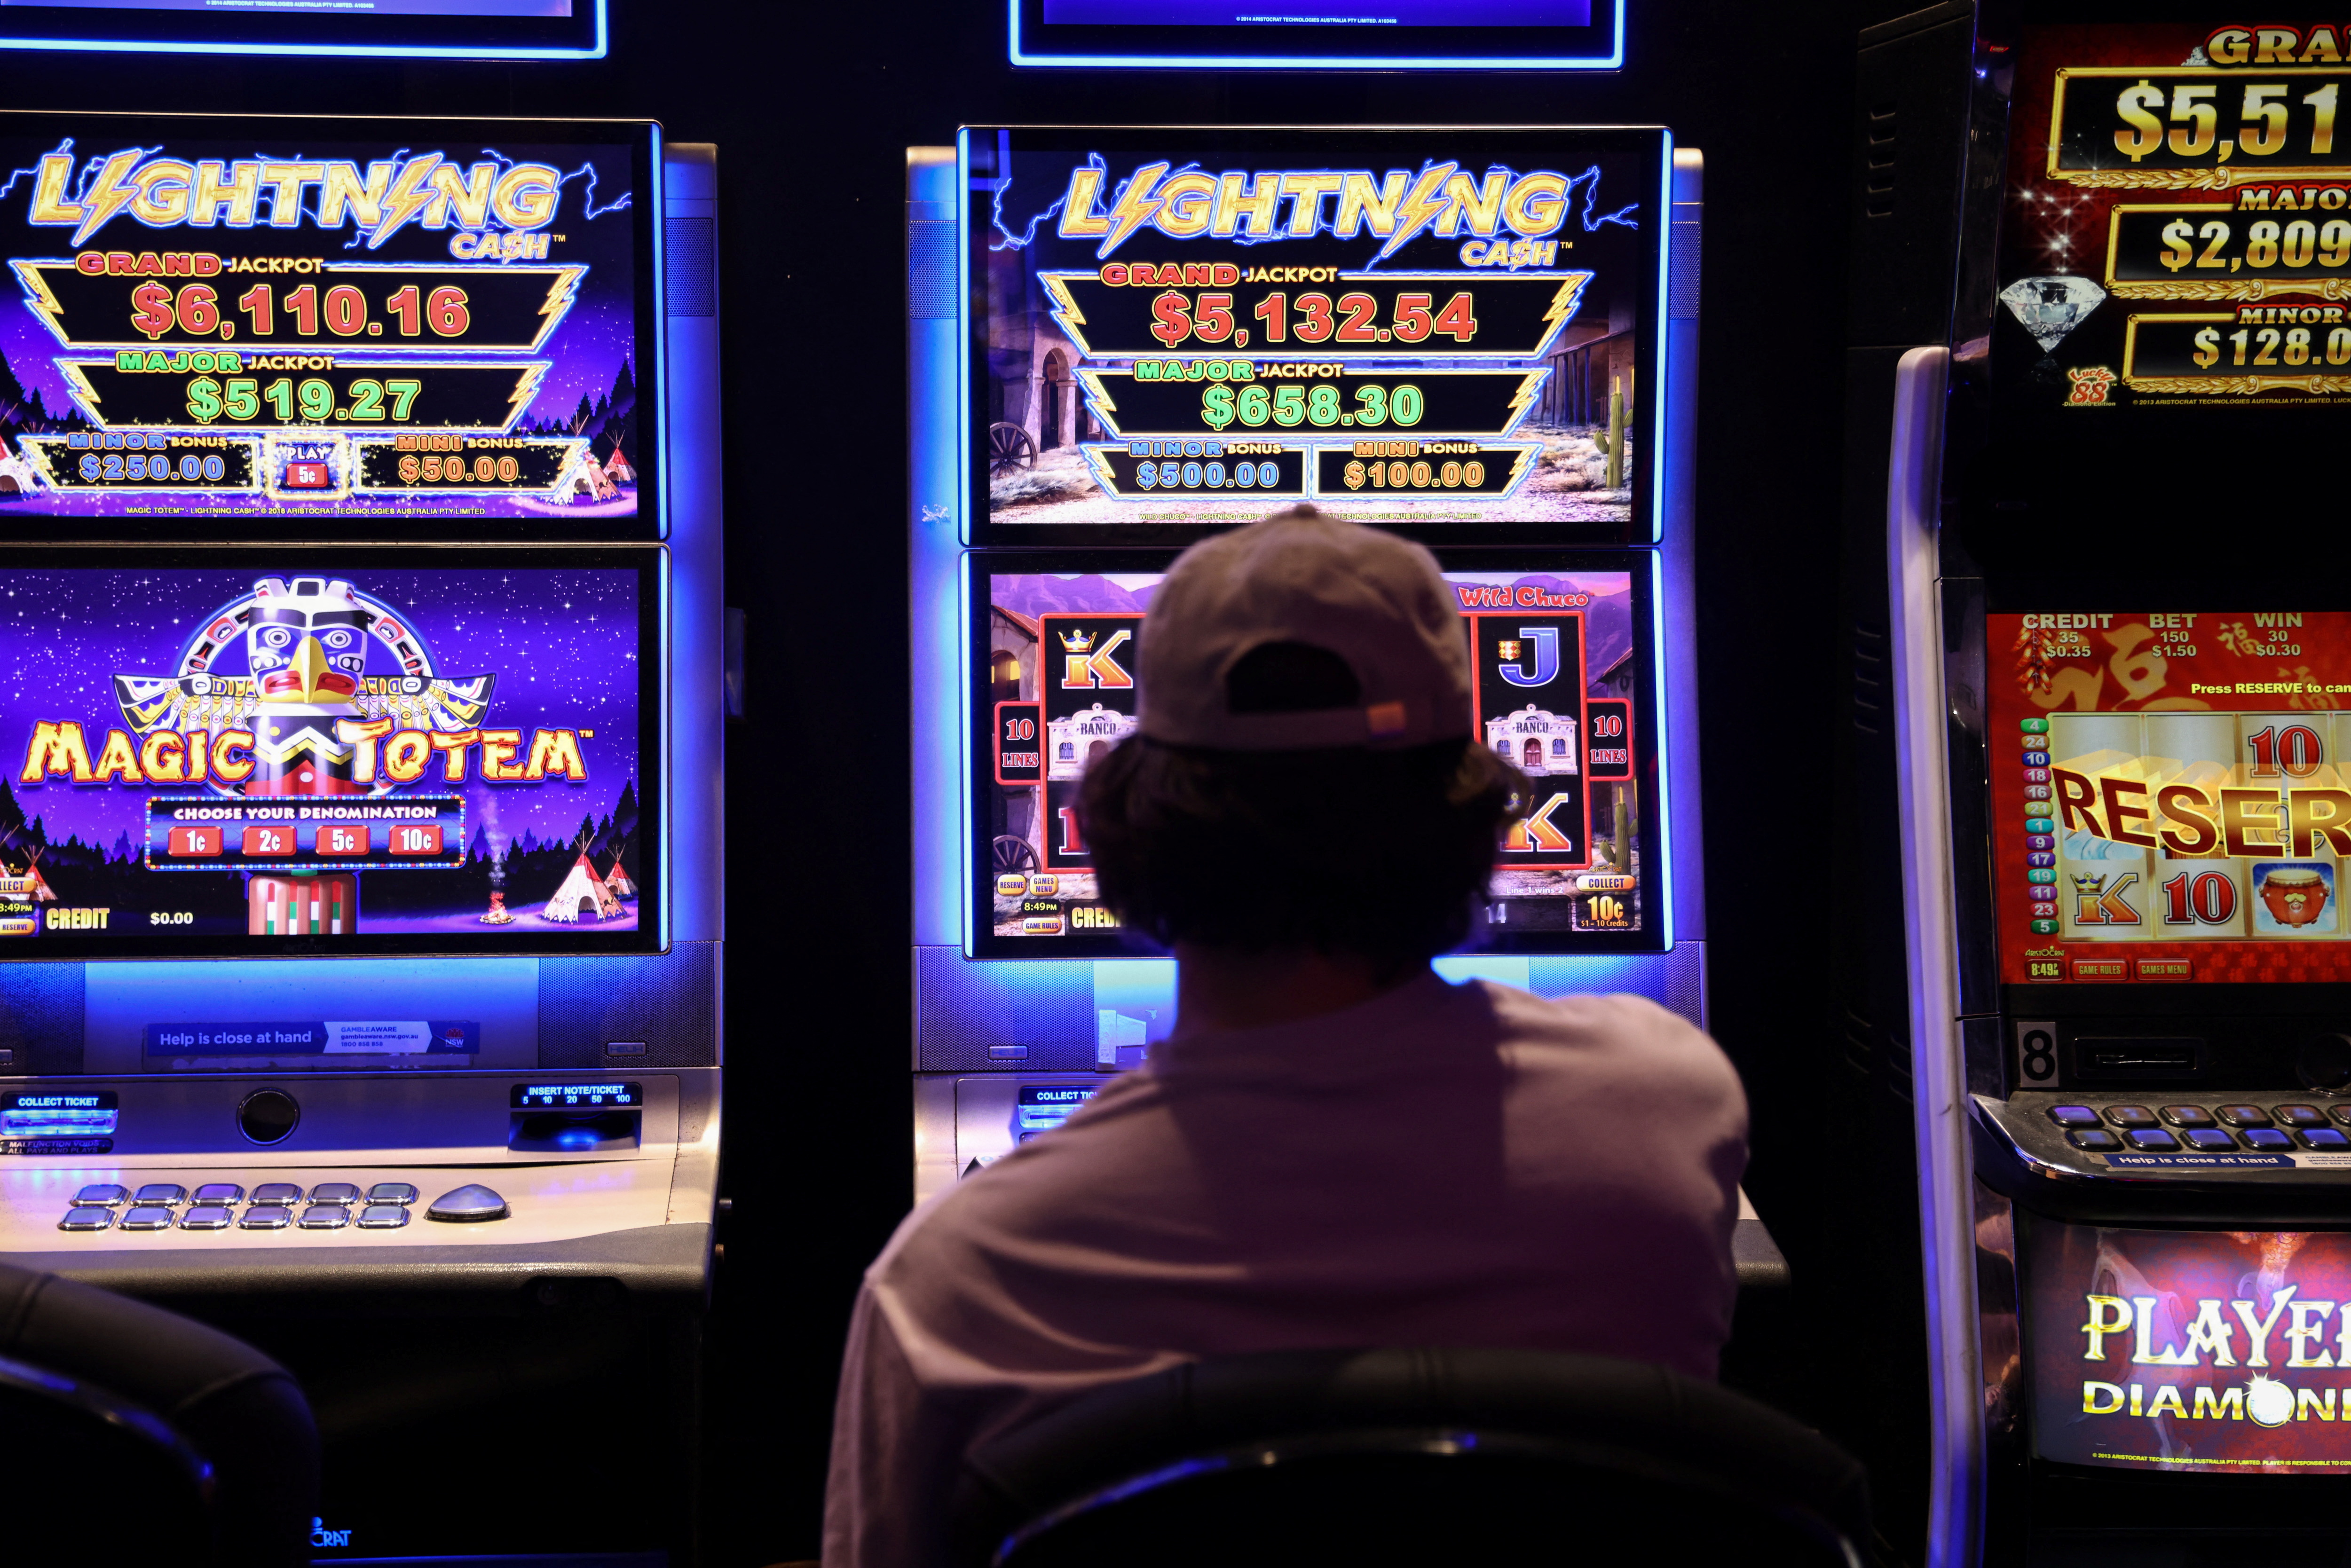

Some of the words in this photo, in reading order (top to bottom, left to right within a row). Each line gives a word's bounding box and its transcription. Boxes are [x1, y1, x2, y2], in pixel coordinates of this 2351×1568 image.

[2208, 29, 2351, 64] GRA
[29, 148, 560, 246] LIGHTNING
[2238, 189, 2351, 211] MAJO
[1057, 162, 1570, 258] LIGHTNING
[74, 252, 222, 276] GRAND
[228, 258, 324, 274] JACKPOT
[1101, 263, 1239, 287] GRAND
[1245, 267, 1338, 284] JACKPOT
[132, 281, 470, 340] $6,110.16
[2239, 307, 2343, 324] MINOR
[1151, 290, 1477, 348] $5,132.54
[115, 350, 242, 373] MAJOR
[247, 355, 334, 370] JACKPOT
[1134, 360, 1255, 382] MAJOR
[1260, 363, 1343, 378] JACKPOT
[186, 376, 421, 425] $519.27
[1201, 383, 1424, 431] $658.30
[67, 433, 167, 450] MINOR
[171, 436, 228, 448] BONUS
[395, 434, 463, 451] MINI
[467, 437, 524, 449] BONUS
[1128, 441, 1223, 457] MINOR
[1228, 443, 1282, 455] BONUS
[1353, 441, 1419, 457] MINI
[1424, 443, 1478, 454] BONUS
[287, 447, 326, 460] PLAY
[79, 454, 225, 482] $250.00
[399, 455, 519, 484] $50.00
[1136, 461, 1279, 490] $500.00
[1344, 460, 1485, 490] $100.00
[1458, 586, 1513, 607] Wild
[2022, 613, 2113, 629] CREDIT
[2149, 613, 2197, 628] BET
[2253, 613, 2302, 627] WIN
[2058, 631, 2079, 643] 35
[2160, 631, 2189, 643] 150
[2268, 630, 2288, 642] 30
[1499, 627, 1560, 687] J
[2046, 644, 2091, 658] $0.35
[2152, 644, 2197, 658] $1.50
[2256, 644, 2301, 657] $0.30
[2191, 683, 2232, 694] Press
[2235, 683, 2303, 694] RESERVE
[2307, 683, 2322, 693] to
[1007, 719, 1034, 741] 10
[1081, 723, 1116, 735] BANCO
[1516, 722, 1548, 733] BANCO
[1594, 716, 1622, 737] 10
[2029, 721, 2040, 731] 4
[2026, 738, 2045, 748] 24
[20, 719, 257, 784] MAGIC
[1590, 749, 1626, 764] LINES
[2027, 754, 2045, 765] 10
[2248, 725, 2323, 778] 10
[1002, 753, 1038, 767] LINES
[2028, 771, 2046, 781] 18
[2029, 788, 2046, 798] 16
[174, 808, 242, 820] CHOOSE
[245, 807, 295, 820] YOUR
[299, 806, 437, 819] DENOMINATION
[2030, 804, 2048, 814] 21
[2036, 821, 2042, 831] 1
[2036, 837, 2045, 848] 9
[2032, 854, 2050, 865] 17
[1588, 878, 1624, 888] COLLECT
[2033, 871, 2051, 882] 19
[2034, 888, 2051, 898] 11
[2074, 872, 2142, 926] K
[2163, 870, 2237, 926] 10
[2034, 905, 2054, 915] 23
[47, 907, 110, 930] CREDIT
[150, 912, 194, 926] $0.00
[2041, 922, 2050, 932] 5
[2079, 966, 2098, 975] GAME
[2100, 965, 2121, 974] RULES
[2141, 965, 2165, 974] GAMES
[2167, 965, 2187, 974] MENU
[160, 1032, 191, 1048] Help
[199, 1032, 210, 1045] is
[214, 1031, 252, 1044] close
[257, 1032, 271, 1043] at
[275, 1031, 312, 1043] hand
[2023, 1030, 2056, 1081] 8
[529, 1087, 562, 1095] INSERT
[564, 1086, 624, 1095] NOTE/TICKET
[1037, 1092, 1079, 1100] COLLECT
[18, 1097, 63, 1106] COLLECT
[64, 1097, 99, 1106] TICKET
